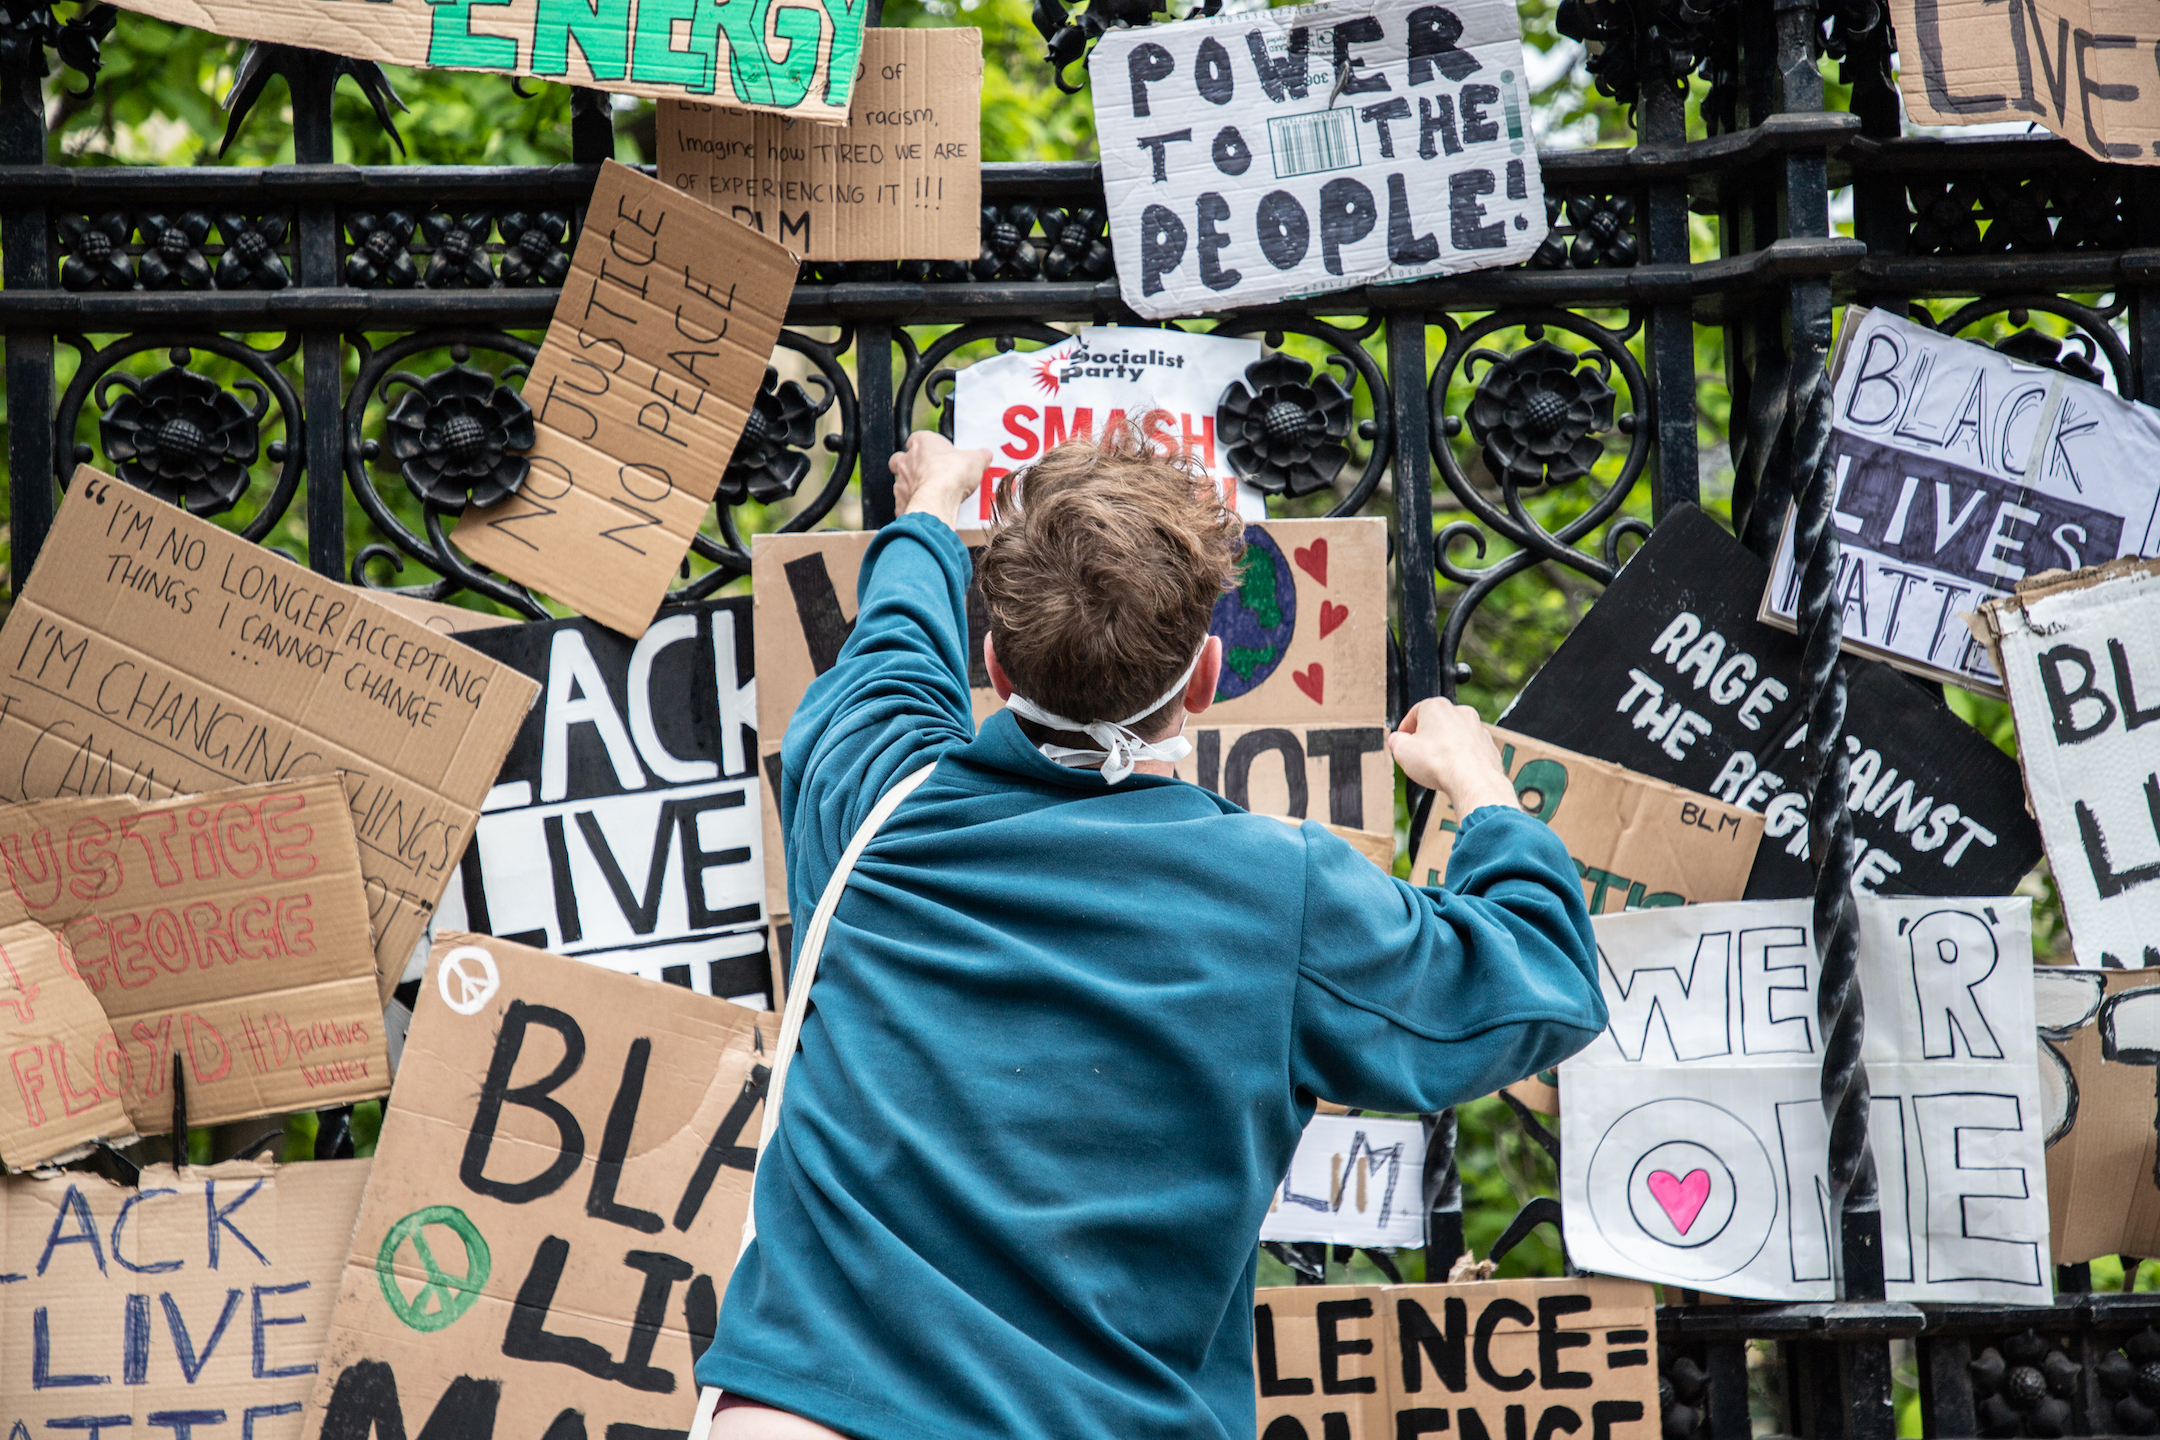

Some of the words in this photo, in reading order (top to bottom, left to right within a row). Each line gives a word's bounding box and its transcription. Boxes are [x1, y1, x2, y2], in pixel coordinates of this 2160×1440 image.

[1127, 5, 1483, 118] POWER
[1914, 0, 2160, 159] LIVE
[676, 173, 699, 190] OF
[710, 177, 865, 204] EXPERIENCING
[678, 130, 755, 161] Imagine
[768, 139, 805, 162] how
[813, 143, 884, 165] TIRED
[895, 144, 922, 161] WE
[933, 142, 968, 160] ARE
[1137, 126, 1253, 183] TO
[1361, 83, 1500, 160] THE
[1141, 158, 1529, 298] PEOPLE!
[487, 455, 573, 551] NO
[540, 194, 666, 440] JUSTICE
[599, 462, 673, 555] NO
[638, 265, 736, 448] PEACE
[1069, 344, 1185, 369] Socialist
[1843, 325, 2098, 494] BLACK
[1833, 453, 2087, 584] LIVES
[16, 618, 89, 690] I'M
[106, 554, 201, 615] THINGS
[219, 602, 228, 630] I
[241, 614, 343, 673] CANNOT
[344, 662, 443, 729] CHANGE
[156, 527, 206, 572] NO
[220, 553, 347, 638] LONGER
[346, 619, 489, 710] ACCEPTING
[1650, 611, 1788, 731] RAGE
[481, 609, 757, 811] ACK
[1616, 668, 1713, 761] THE
[1680, 802, 1742, 842] BLM
[57, 893, 316, 992] GEORGE
[1597, 925, 1815, 1062] WE
[9, 1012, 232, 1128] FLOYD
[33, 1280, 319, 1391] LIVE
